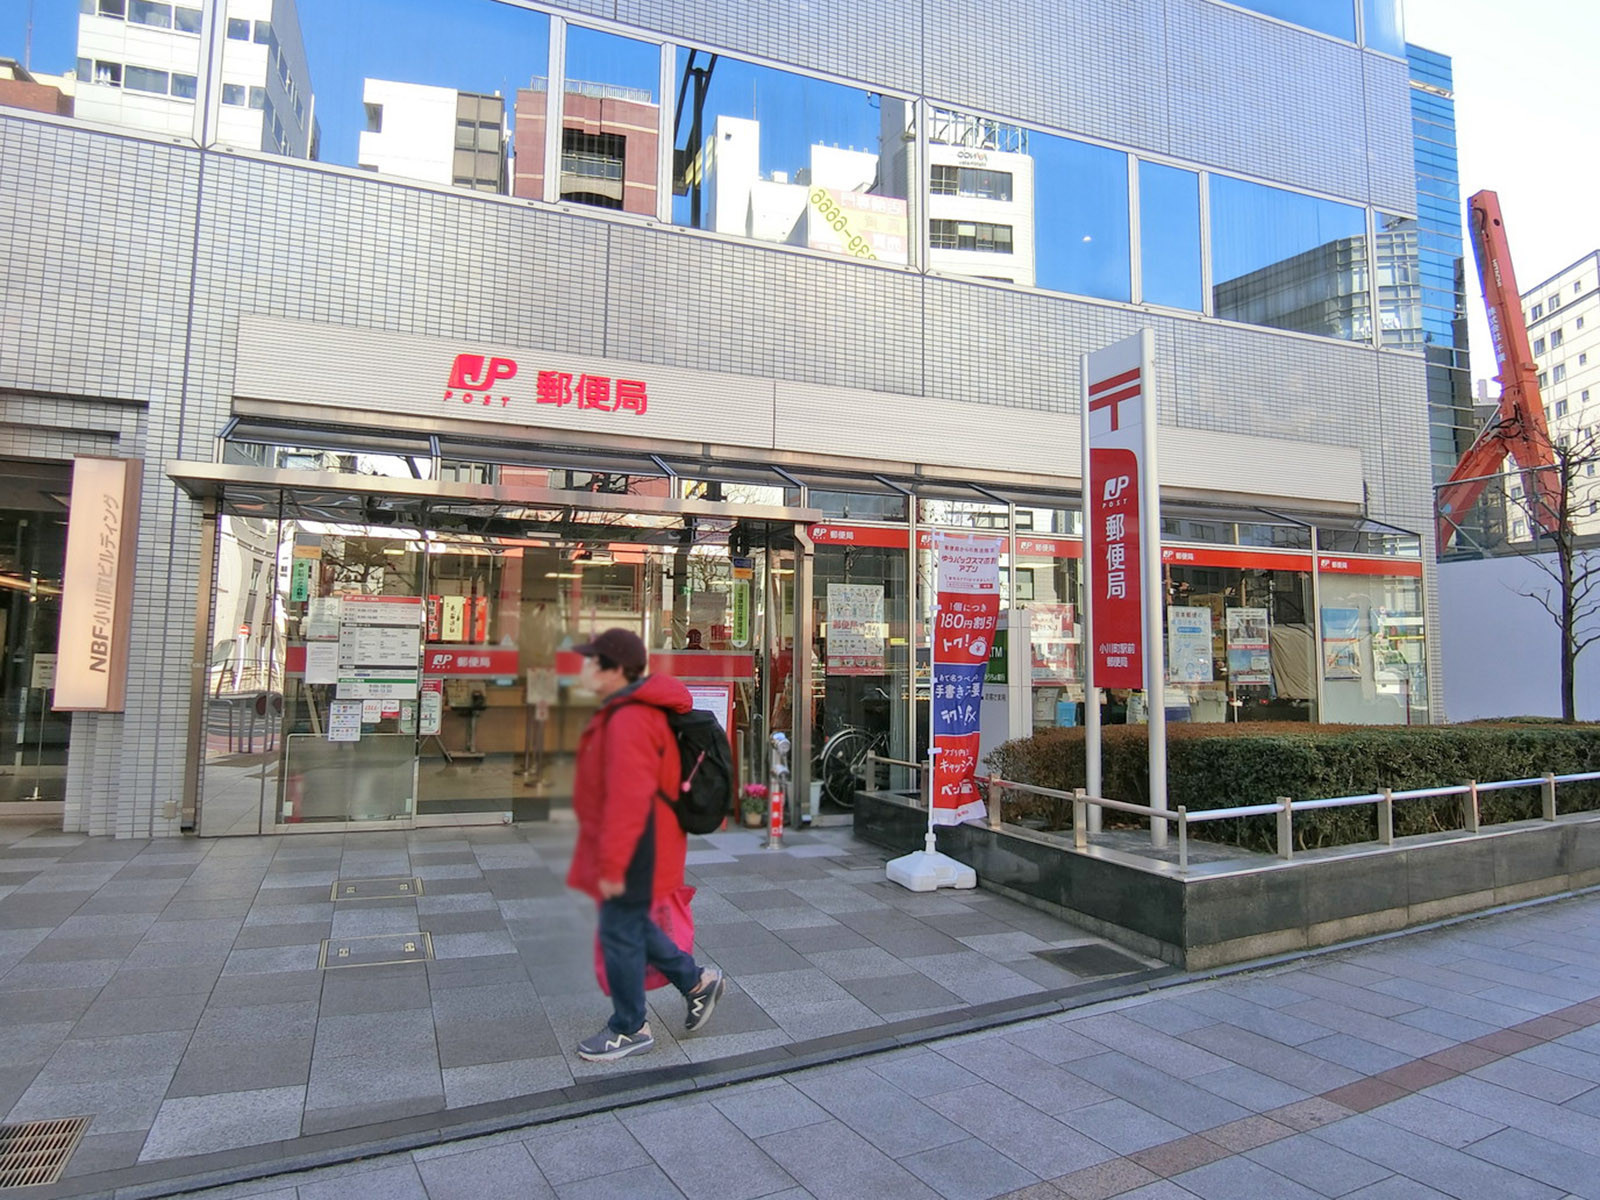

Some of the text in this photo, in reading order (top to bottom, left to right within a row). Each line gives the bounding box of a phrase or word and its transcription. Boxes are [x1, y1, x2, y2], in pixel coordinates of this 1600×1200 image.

[1491, 258, 1502, 288] HITACHI
[447, 353, 518, 391] JP
[443, 390, 511, 407] POST
[536, 370, 648, 415] 郵便局
[1102, 474, 1130, 501] JP
[1101, 498, 1128, 509] POST
[812, 527, 827, 537] JP
[829, 530, 854, 541] 郵便局
[1035, 543, 1055, 553] 郵便局
[1105, 512, 1126, 599] 郵便局
[1175, 552, 1194, 561] 郵便局
[959, 564, 979, 573] アプリ
[949, 601, 987, 612] 1個につき
[942, 634, 970, 652] トク!
[1099, 642, 1136, 655] 小川町駅前
[989, 646, 1003, 658] TM
[432, 654, 453, 665] JP
[457, 656, 491, 668] 郵便局
[1106, 656, 1128, 668] 郵便局
[940, 704, 963, 725] ラク!
